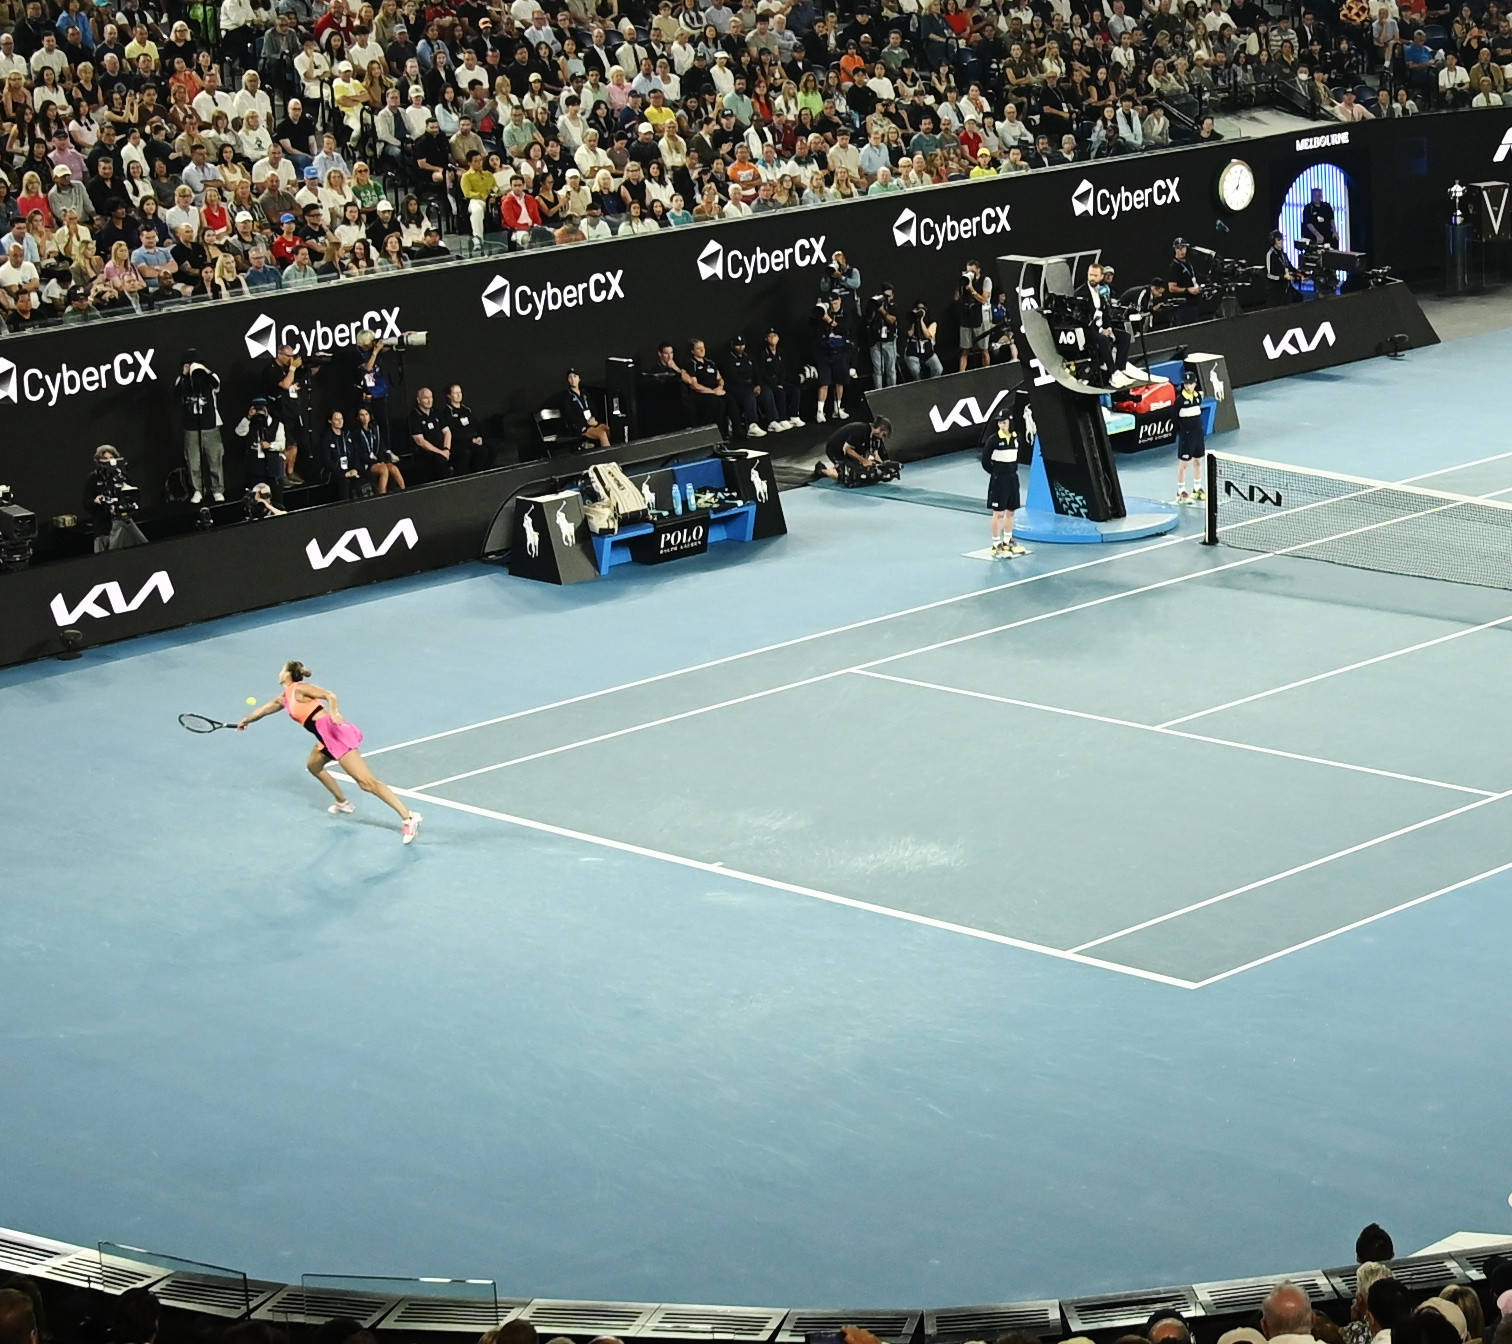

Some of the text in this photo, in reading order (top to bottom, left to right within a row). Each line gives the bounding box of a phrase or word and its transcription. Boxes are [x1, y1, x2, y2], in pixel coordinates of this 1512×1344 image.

[1296, 131, 1350, 152] MELBOURNE
[1097, 177, 1181, 220] CyberCX
[921, 205, 1012, 251] CyberCX
[728, 236, 827, 284] CyberCX
[515, 270, 625, 321] CyberCX
[1058, 330, 1076, 345] AO
[1263, 321, 1337, 360] KIA
[24, 349, 158, 407] CyberCX
[1139, 419, 1174, 439] POLO
[306, 518, 419, 570] KIA
[660, 525, 704, 549] POLO
[50, 571, 175, 627] KIA
